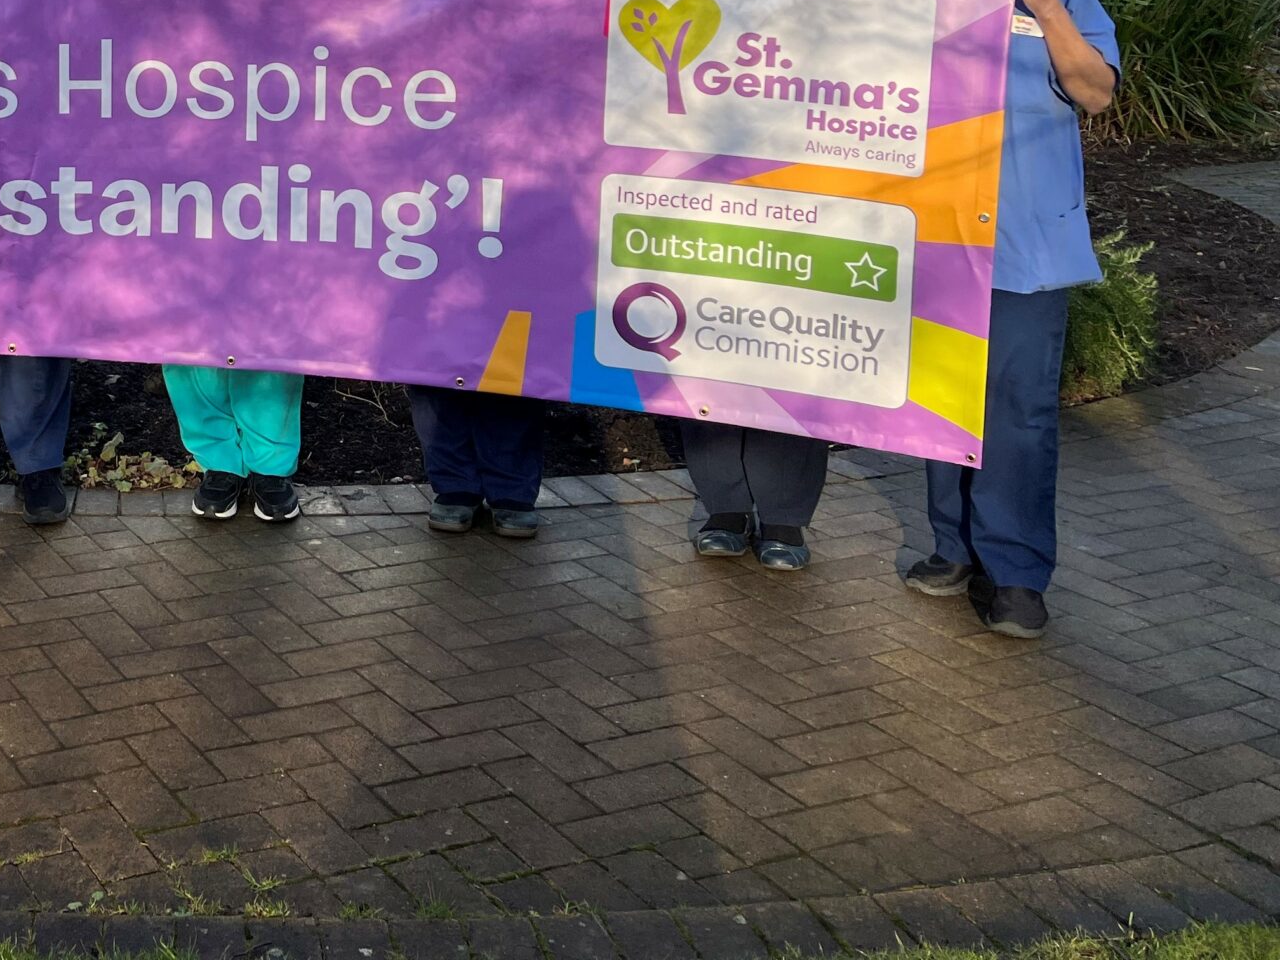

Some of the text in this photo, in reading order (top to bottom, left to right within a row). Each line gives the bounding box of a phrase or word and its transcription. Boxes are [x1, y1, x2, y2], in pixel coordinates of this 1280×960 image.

[735, 32, 793, 69] St.
[57, 38, 457, 142] Hospice
[693, 61, 920, 113] Gemma’s
[806, 109, 918, 142] Hospice
[805, 140, 916, 168] Always caring
[617, 186, 818, 224] Inspected and rated
[625, 228, 812, 281] Outstanding
[695, 326, 879, 376] Commission
